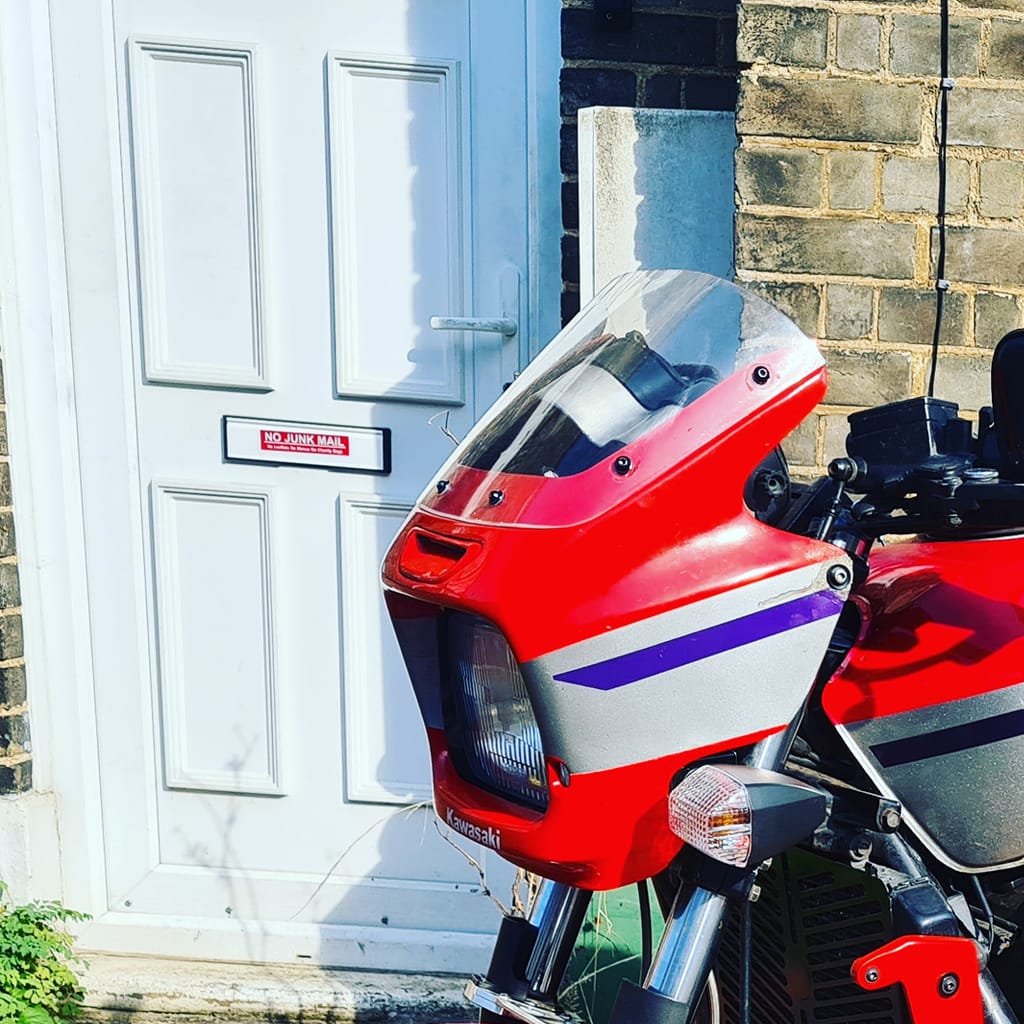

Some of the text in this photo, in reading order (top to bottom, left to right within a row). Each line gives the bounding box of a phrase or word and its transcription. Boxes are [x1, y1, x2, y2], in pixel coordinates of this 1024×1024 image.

[264, 432, 345, 447] NO JUNK MAIL
[446, 807, 501, 849] Kawasaki
